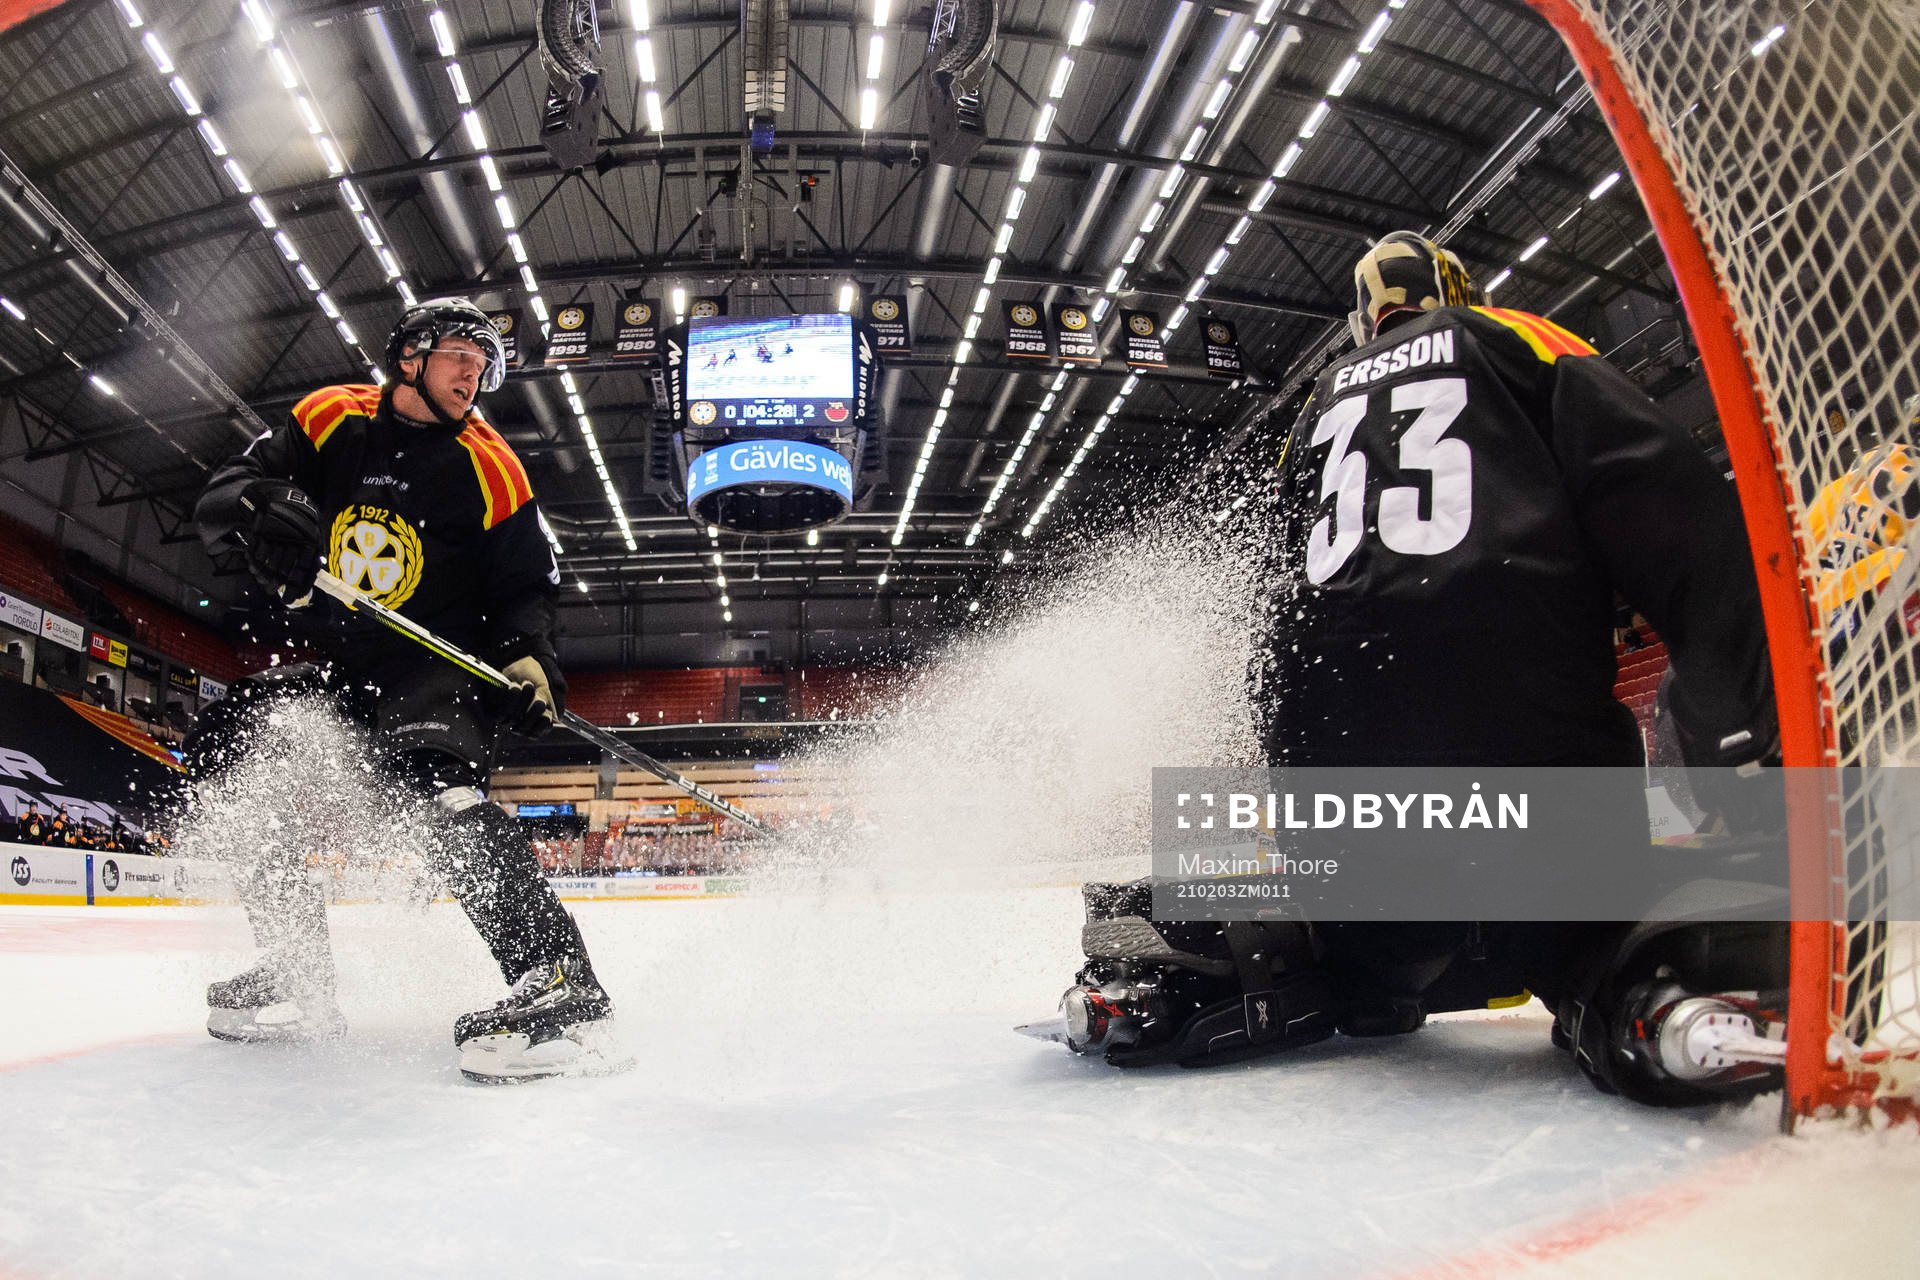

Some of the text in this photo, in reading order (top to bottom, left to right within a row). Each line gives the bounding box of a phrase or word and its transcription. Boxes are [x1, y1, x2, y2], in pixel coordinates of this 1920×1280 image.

[616, 340, 656, 351] 1980
[877, 336, 905, 346] 971
[1008, 341, 1046, 351] 1968
[1129, 337, 1159, 345] SVENSKA
[549, 344, 588, 356] 1993
[1060, 344, 1096, 354] 1967
[1128, 350, 1164, 361] 1966
[1333, 329, 1454, 395] ERSSON
[725, 405, 736, 418] 0
[803, 404, 815, 417] 2
[730, 445, 817, 472] Gävles
[1306, 378, 1473, 585] 33
[359, 504, 389, 522] 1912
[364, 532, 375, 547] B
[379, 566, 390, 580] F
